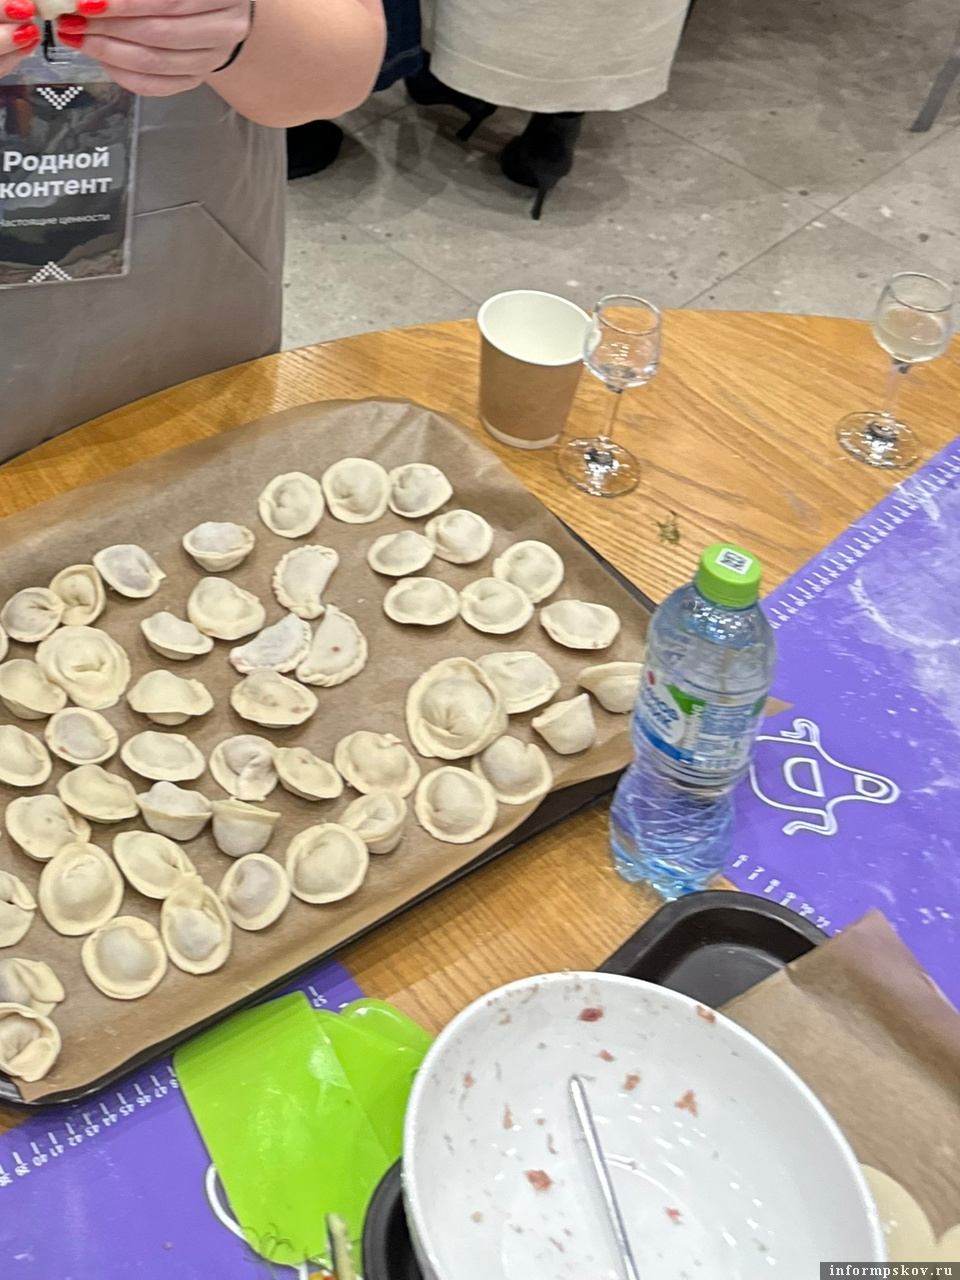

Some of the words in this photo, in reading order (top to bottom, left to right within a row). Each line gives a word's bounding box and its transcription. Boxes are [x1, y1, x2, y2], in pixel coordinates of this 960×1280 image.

[2, 146, 110, 174] Родной
[59, 213, 111, 225] ценности
[154, 1086, 168, 1098] 47
[119, 1104, 135, 1117] 45
[102, 1113, 118, 1127] 44
[67, 1134, 83, 1147] 42
[49, 1144, 64, 1157] 41
[32, 1153, 48, 1167] 40
